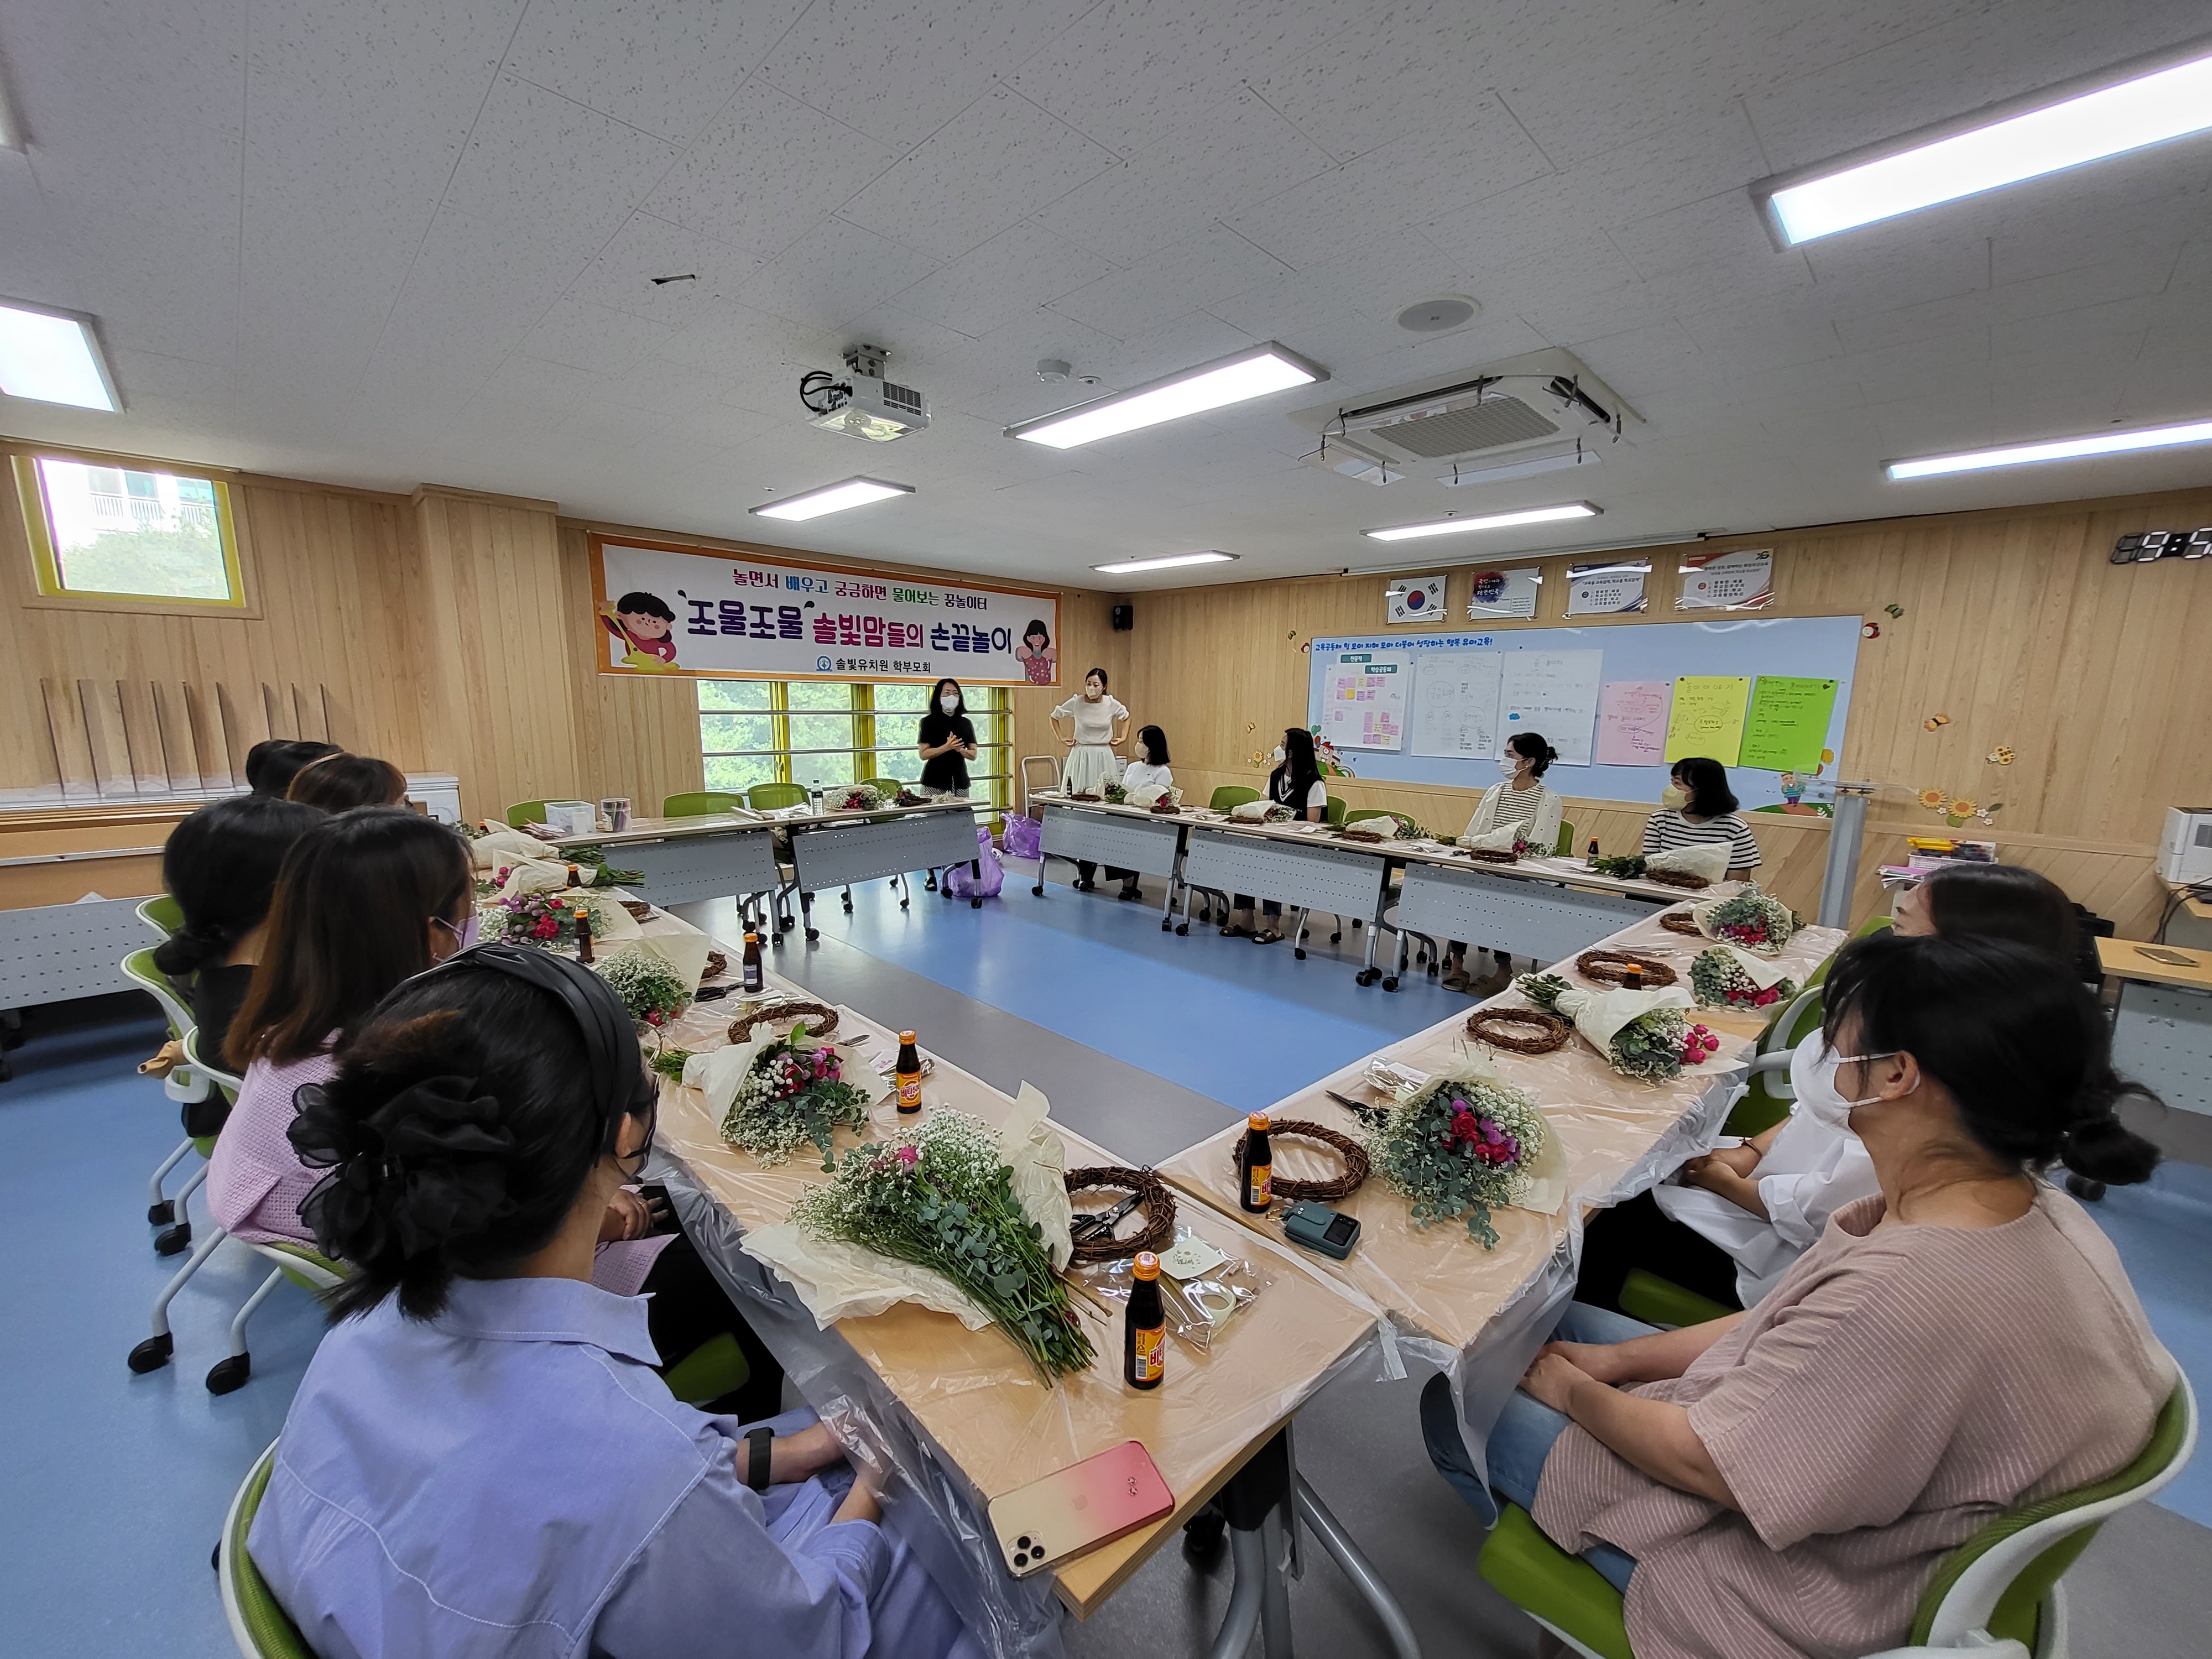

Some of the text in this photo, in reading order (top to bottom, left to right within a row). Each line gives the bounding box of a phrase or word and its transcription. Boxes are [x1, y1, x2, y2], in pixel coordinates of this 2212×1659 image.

[2137, 527, 2212, 562] 9:5
[733, 569, 988, 611] 놀면서 배우고 궁금하면 물어보는 꿈놀이터
[813, 612, 924, 649] 솔빛맘들의
[930, 622, 1012, 654] 손끝놀이
[1315, 643, 1342, 651] 교육공동체
[1395, 640, 1415, 649] 더불어
[1416, 639, 1444, 648] 성장하는
[1446, 638, 1460, 647] 행복
[1462, 637, 1493, 646] 유아교육!
[836, 658, 931, 674] 솔빛유치원 학부모회
